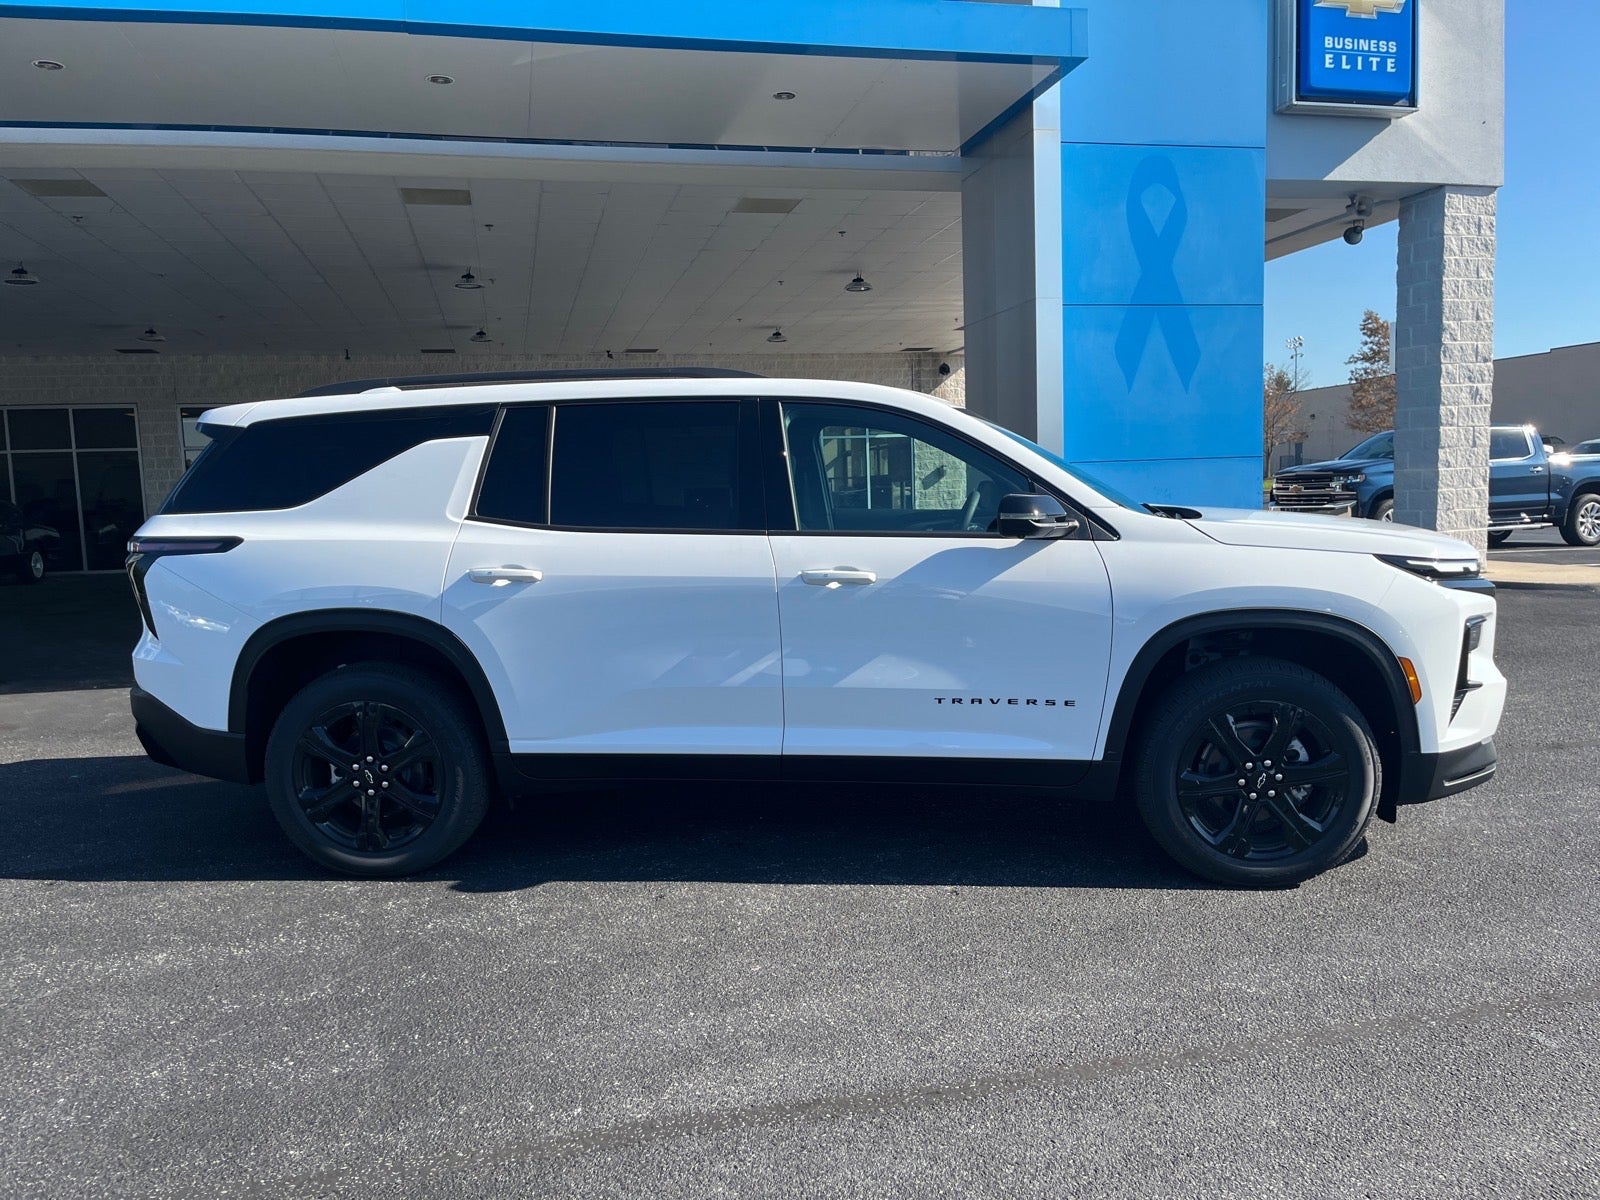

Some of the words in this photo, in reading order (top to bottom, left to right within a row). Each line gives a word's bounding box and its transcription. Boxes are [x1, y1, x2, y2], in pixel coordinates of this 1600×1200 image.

[1324, 36, 1397, 53] BUSINESS
[1324, 53, 1397, 73] ELITE
[934, 697, 1076, 707] TRAVERSE
